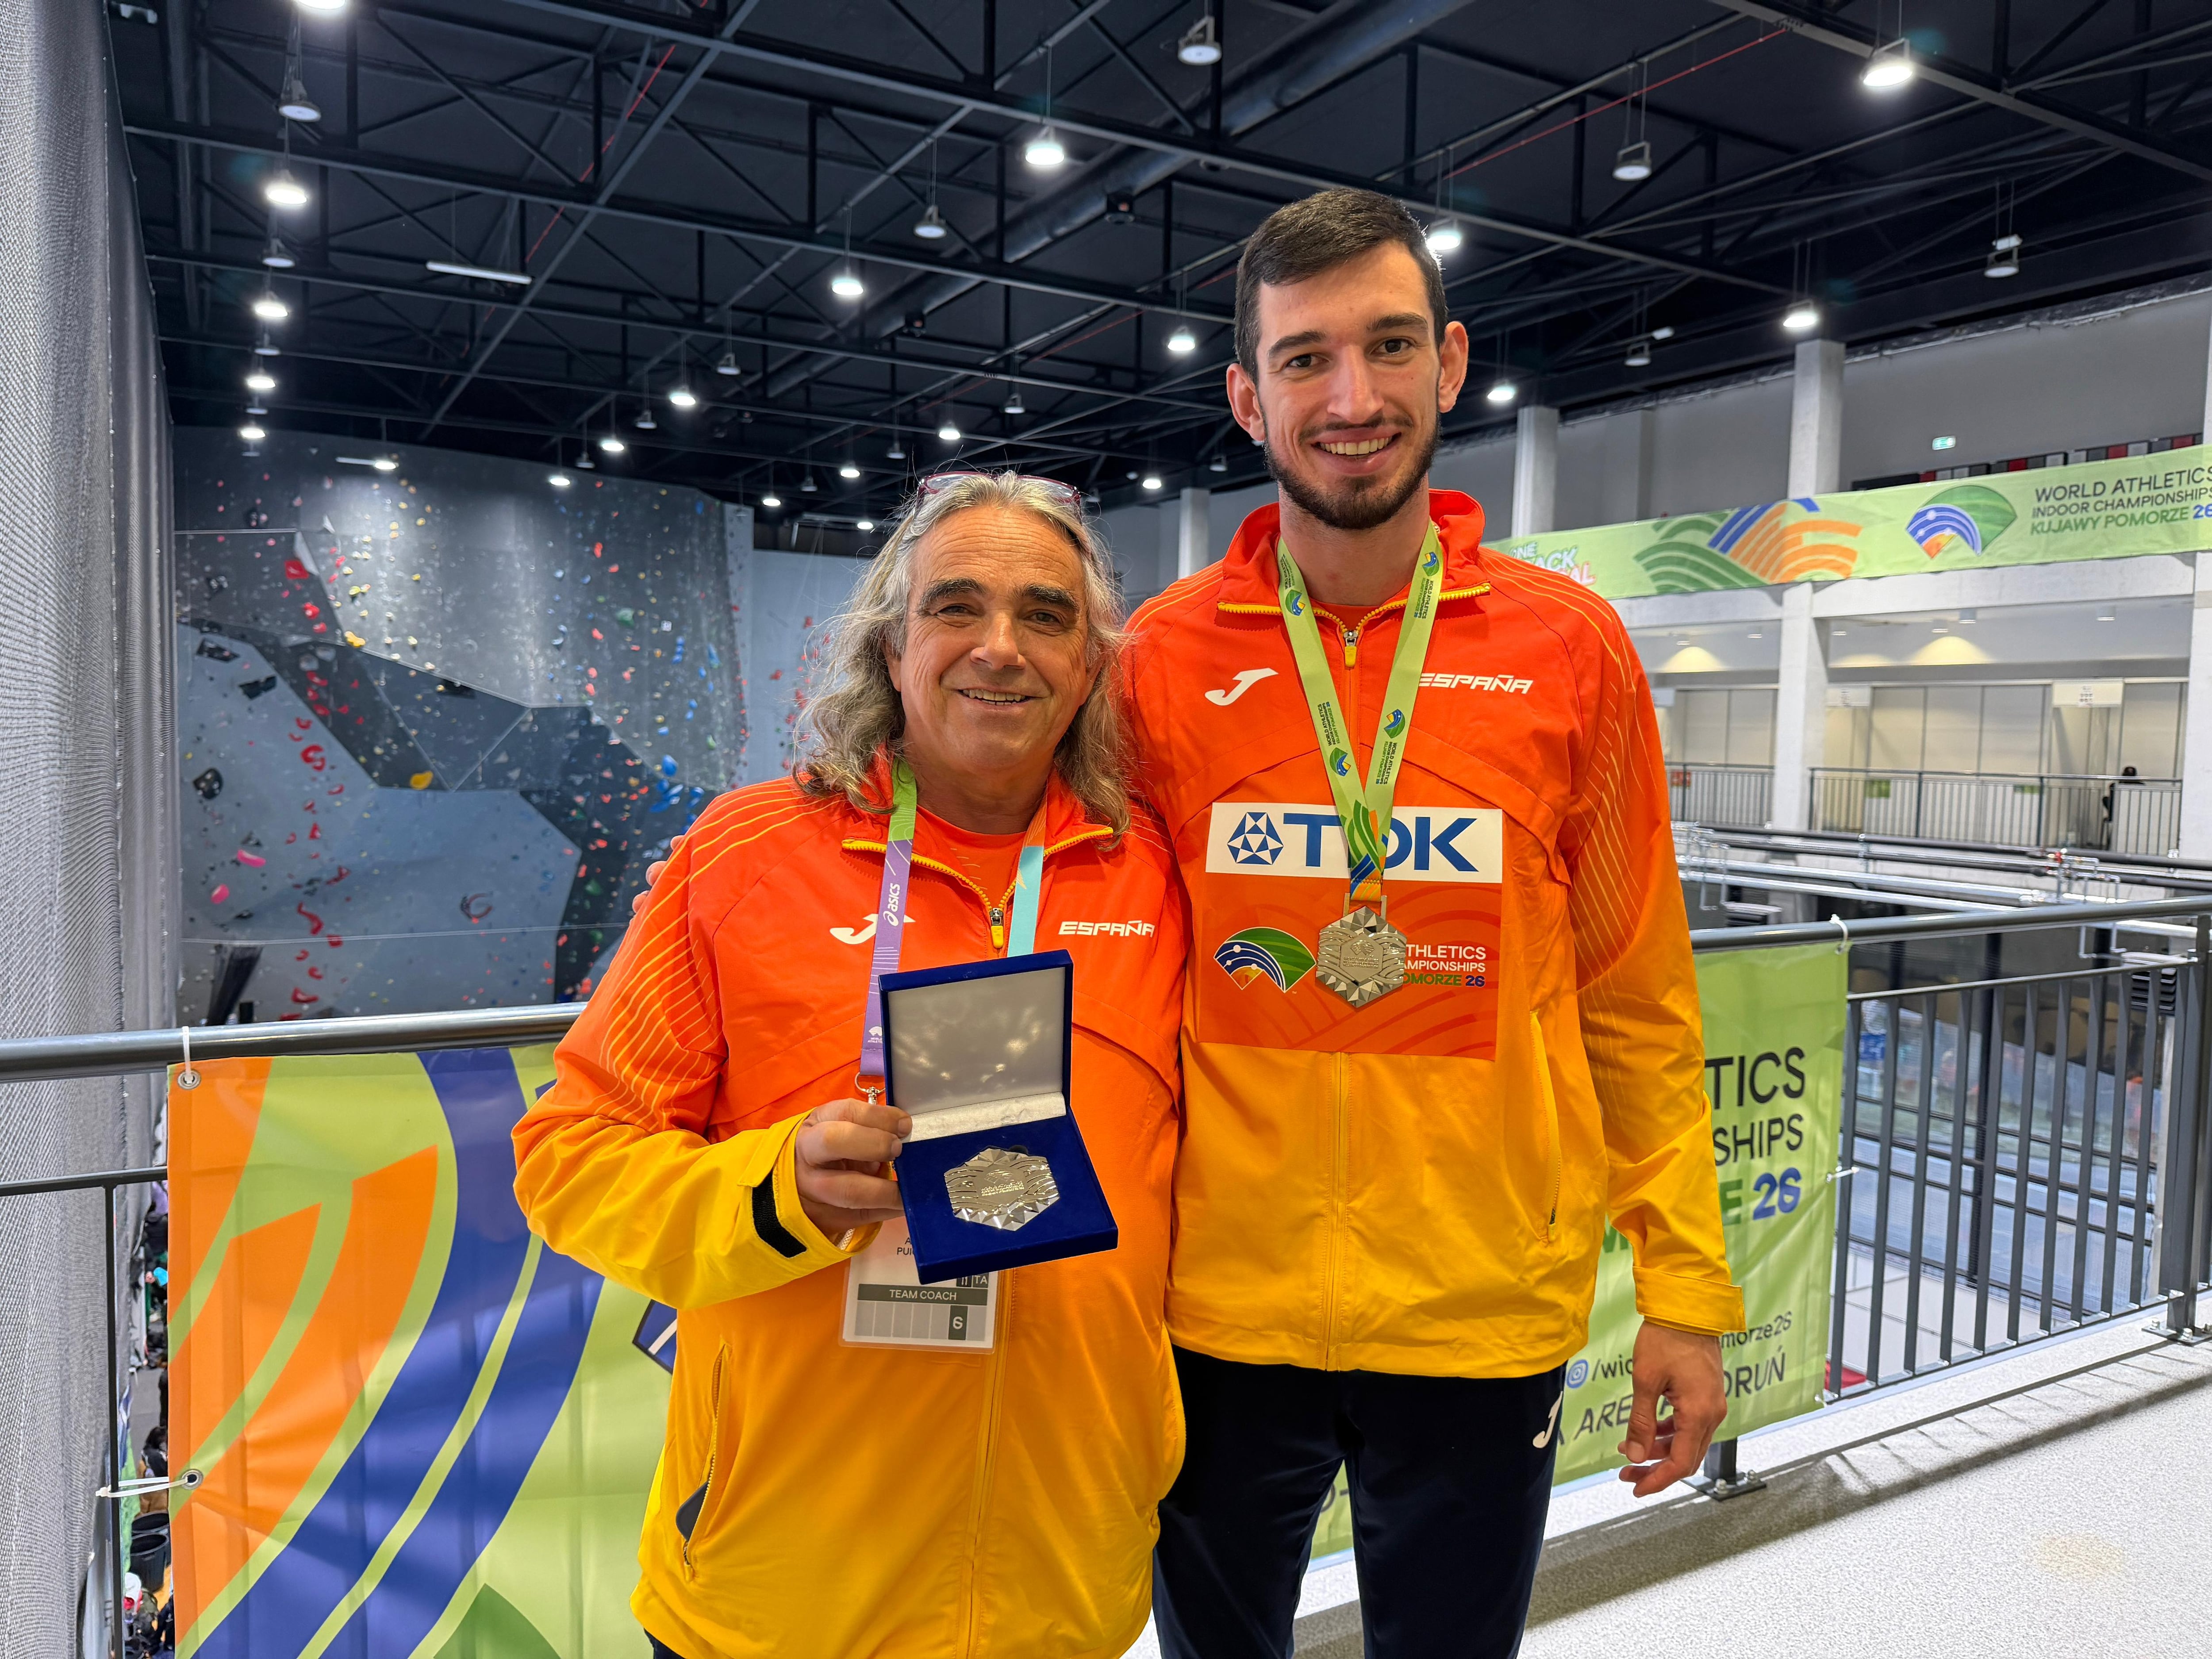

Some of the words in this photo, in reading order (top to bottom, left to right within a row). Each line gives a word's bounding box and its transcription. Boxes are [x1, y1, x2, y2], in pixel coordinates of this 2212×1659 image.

[2035, 481, 2106, 502] WORLD
[2032, 502, 2089, 518] INDOOR
[2031, 516, 2101, 535] KUJAWY
[2104, 507, 2189, 528] POMORZE
[1526, 547, 1577, 571] ACK
[1419, 673, 1533, 694] ESPAÑA
[1317, 704, 1327, 729] ATHLETICS
[1383, 760, 1393, 784] ATHLETICS
[887, 883, 900, 912] asics
[1058, 920, 1155, 938] ESPAÑA
[1406, 944, 1486, 960] THLETICS
[1404, 960, 1486, 972] MPIONSHIPS
[1403, 973, 1462, 986] OMORZE
[1465, 975, 1485, 987] 26
[1705, 1046, 1805, 1109] TICS
[1713, 1114, 1803, 1166] SHIPS
[1719, 1179, 1743, 1226] E
[1753, 1167, 1802, 1221] 26
[974, 1275, 987, 1284] TA
[889, 1289, 918, 1299] TEAM
[920, 1290, 957, 1301] COACH
[952, 1316, 963, 1329] 6
[1721, 1311, 1792, 1348] morze26
